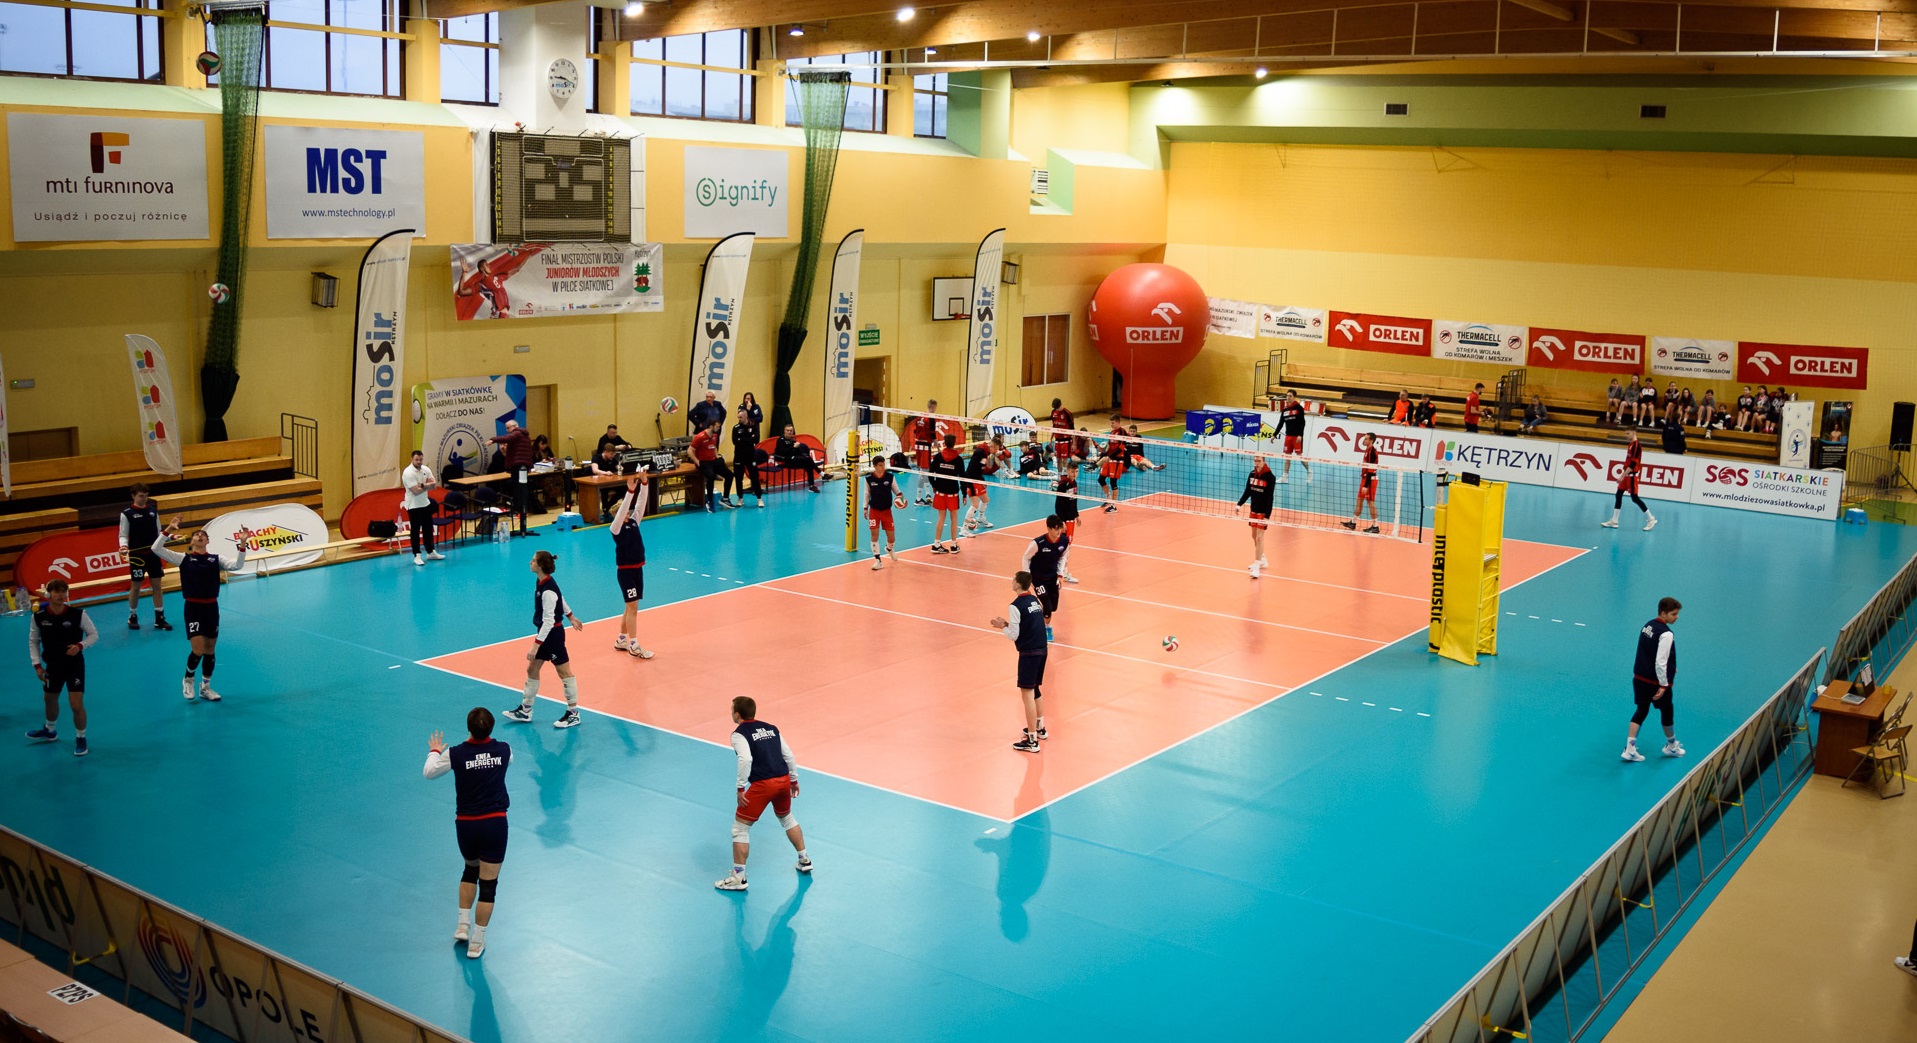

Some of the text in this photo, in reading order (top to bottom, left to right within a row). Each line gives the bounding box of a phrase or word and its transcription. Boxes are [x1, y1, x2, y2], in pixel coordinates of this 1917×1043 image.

[306, 147, 387, 195] MST
[34, 211, 188, 223] Usiądź i poczuj różnicę
[302, 208, 396, 219] www.mstechnology.pl
[541, 252, 624, 265] FINAŁ MISTRZOSTW POLSKI
[545, 265, 620, 279] JUNIORÓW MŁODSZYCH
[552, 280, 614, 292] W PIŁCE SIATKOWEJ
[1275, 316, 1308, 326] THERMACELL
[1129, 329, 1180, 342] ORLEN
[1372, 327, 1420, 343] ORLEN
[1457, 331, 1502, 343] THERMACELL
[1453, 352, 1484, 361] KOMARÓW
[1456, 346, 1478, 354] STREFA
[1577, 344, 1636, 361] ORLEN
[1672, 351, 1713, 361] THERMACELL
[1793, 358, 1853, 375] ORLEN
[452, 386, 493, 398] SIATKÓWKĘ
[458, 394, 498, 405] MAZURACH
[457, 408, 468, 417] DO
[1456, 444, 1552, 472] KĘTRZYN
[1611, 463, 1680, 486] OLEN
[1754, 469, 1830, 486] SIATKARSKIE
[1752, 480, 1828, 497] OŚRODKI SZKOLNE
[1702, 490, 1826, 513] www.mlodziezowasiatkowka.pl
[233, 527, 277, 540] BACHY
[90, 554, 129, 570] ORLE
[132, 568, 144, 578] 33
[627, 587, 638, 599] 28
[1036, 585, 1046, 596] 30
[189, 621, 200, 633] 27
[465, 757, 502, 770] ENERGETYK
[50, 983, 94, 1003] PZPS
